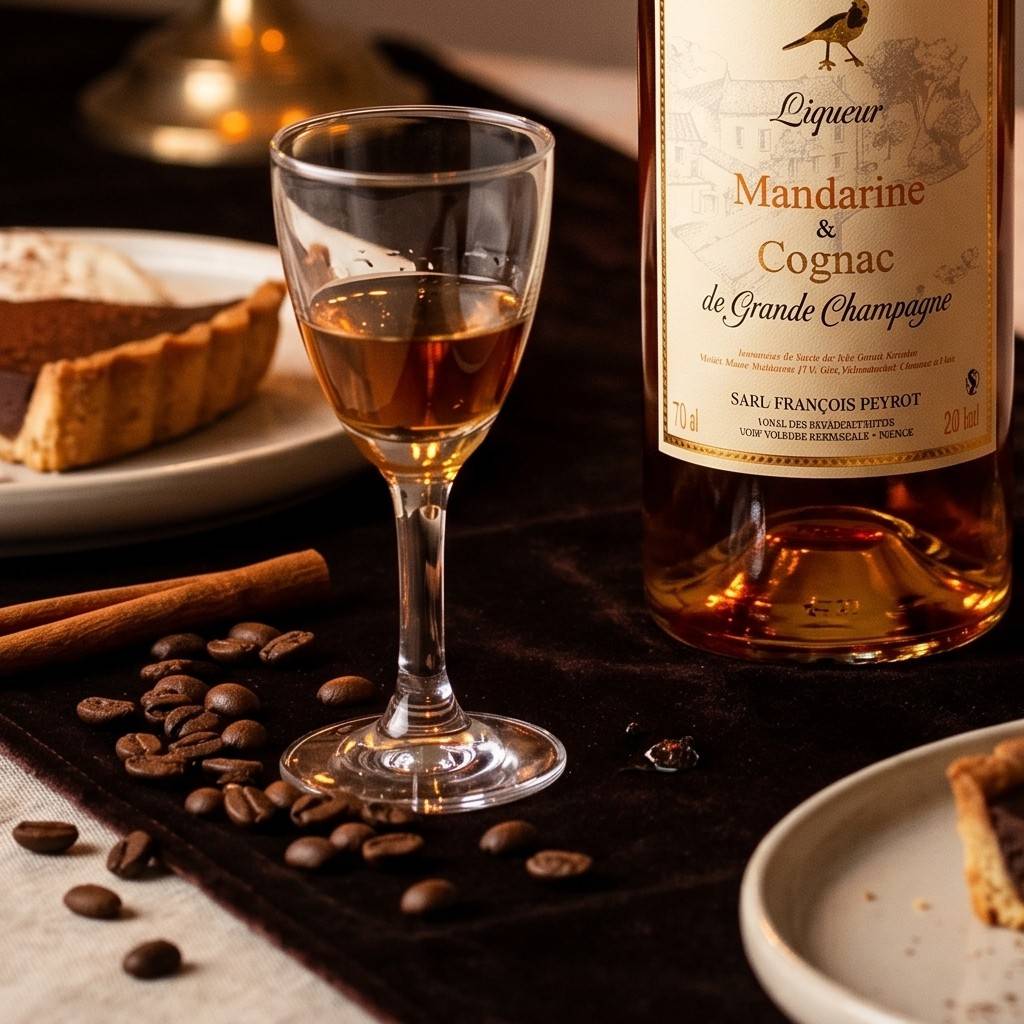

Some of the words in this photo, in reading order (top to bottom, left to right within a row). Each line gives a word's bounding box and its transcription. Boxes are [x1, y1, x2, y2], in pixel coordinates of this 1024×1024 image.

[769, 91, 884, 137] Liqueur
[733, 173, 926, 210] Mandarine
[816, 219, 837, 239] &
[757, 240, 895, 284] Cognac
[702, 284, 725, 314] de
[722, 290, 816, 328] Grande
[820, 291, 953, 330] Champagne
[672, 400, 687, 430] 70
[730, 391, 770, 409] SARL
[774, 396, 856, 415] FRANÇOIS
[860, 392, 922, 411] PEYROT
[789, 419, 807, 429] DES
[943, 408, 960, 435] 20
